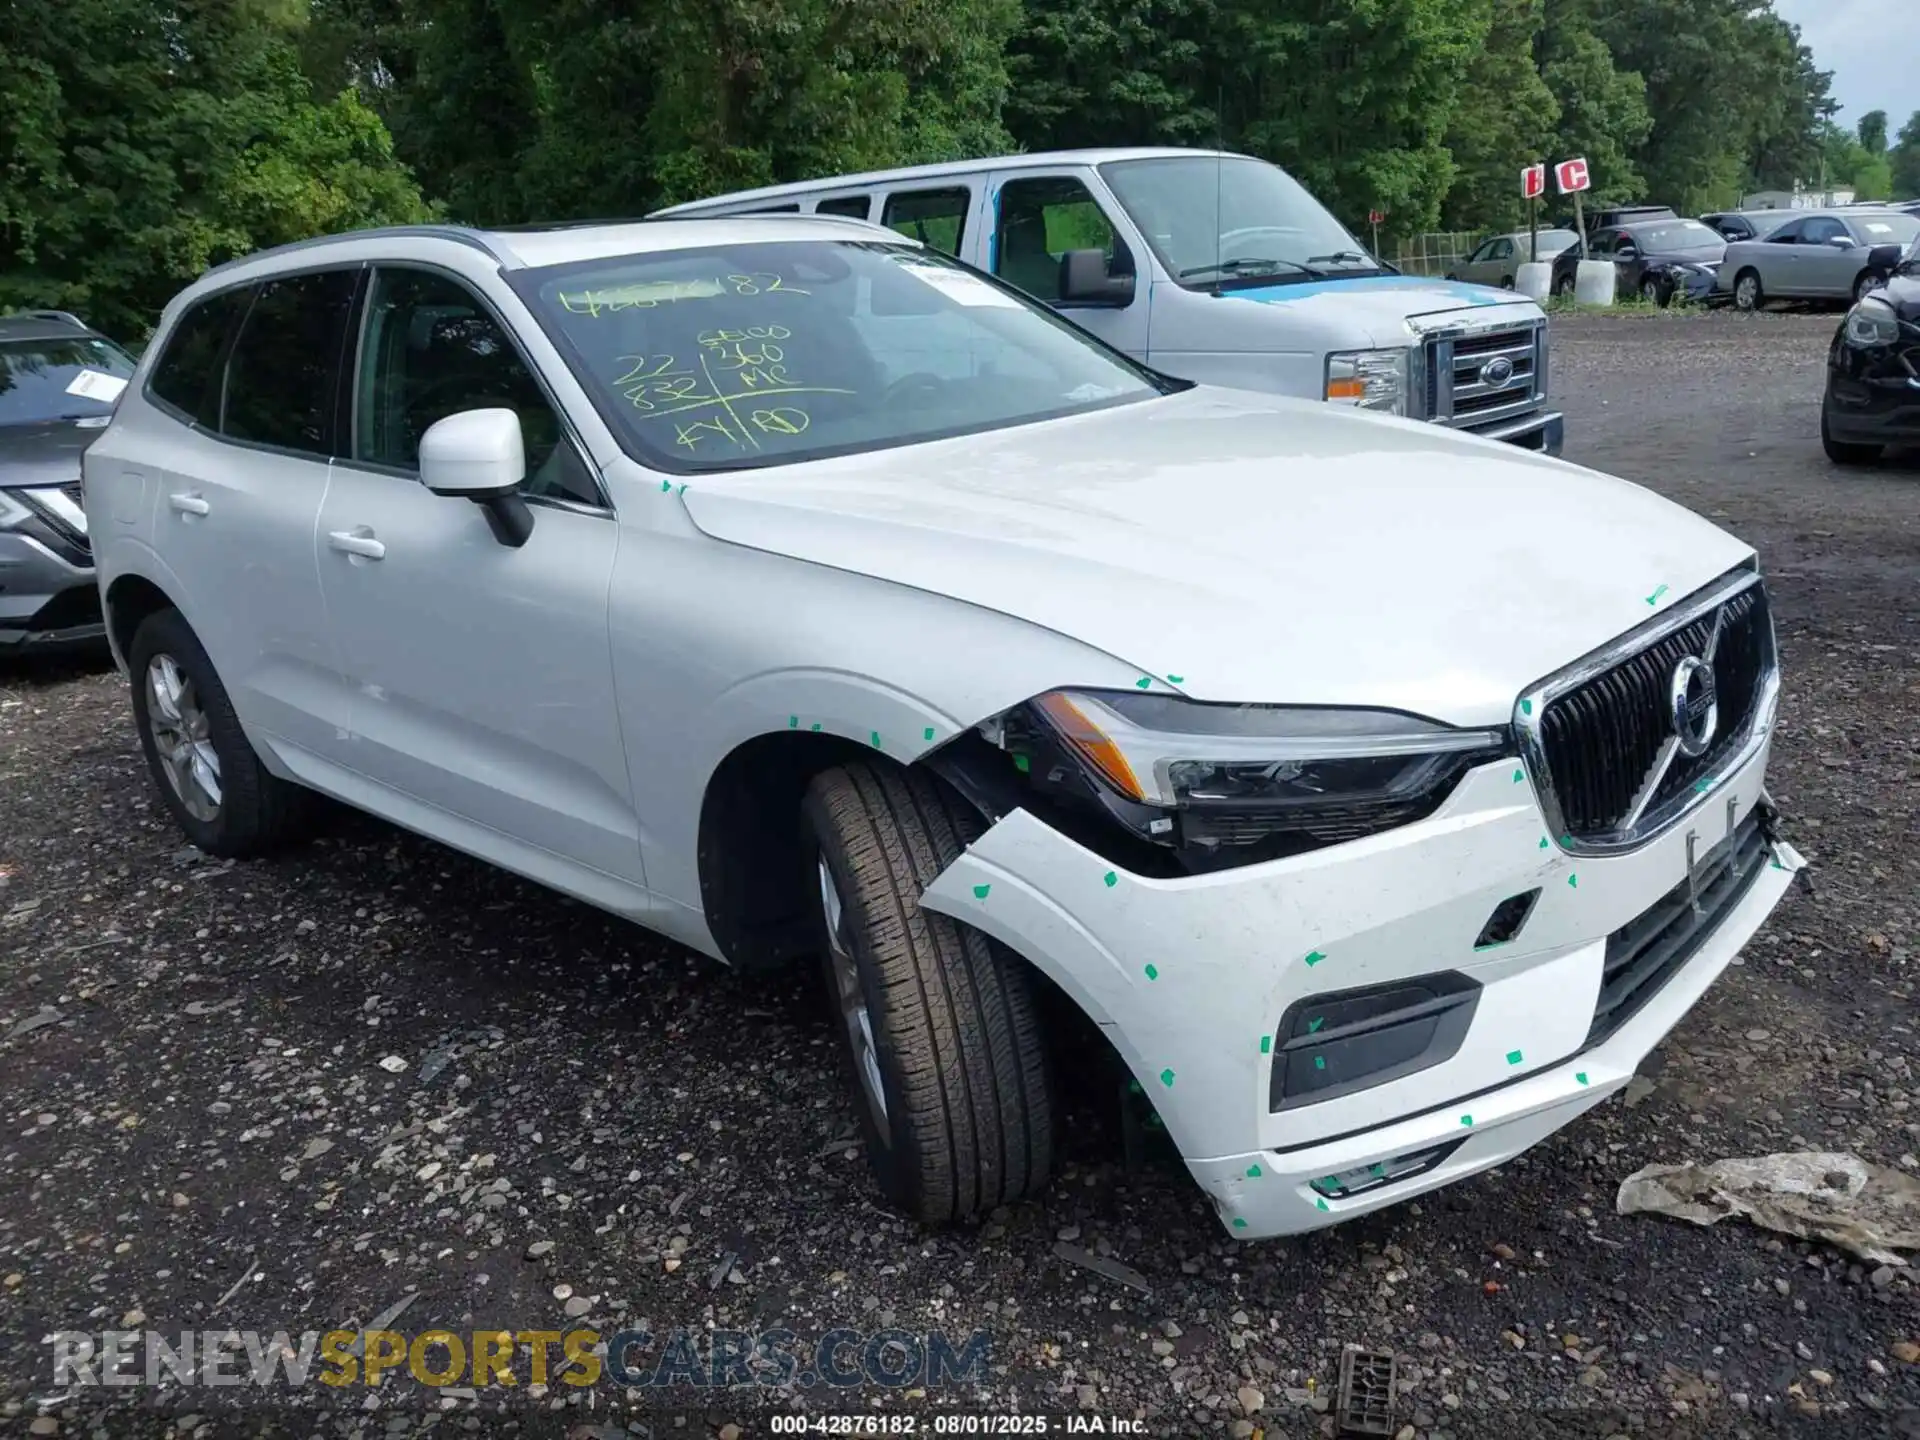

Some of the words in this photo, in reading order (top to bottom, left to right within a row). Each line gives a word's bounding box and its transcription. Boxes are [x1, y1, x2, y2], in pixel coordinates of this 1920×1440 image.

[1560, 161, 1587, 190] C
[612, 354, 694, 385] 22
[739, 364, 804, 388] MC
[623, 377, 711, 410] 832
